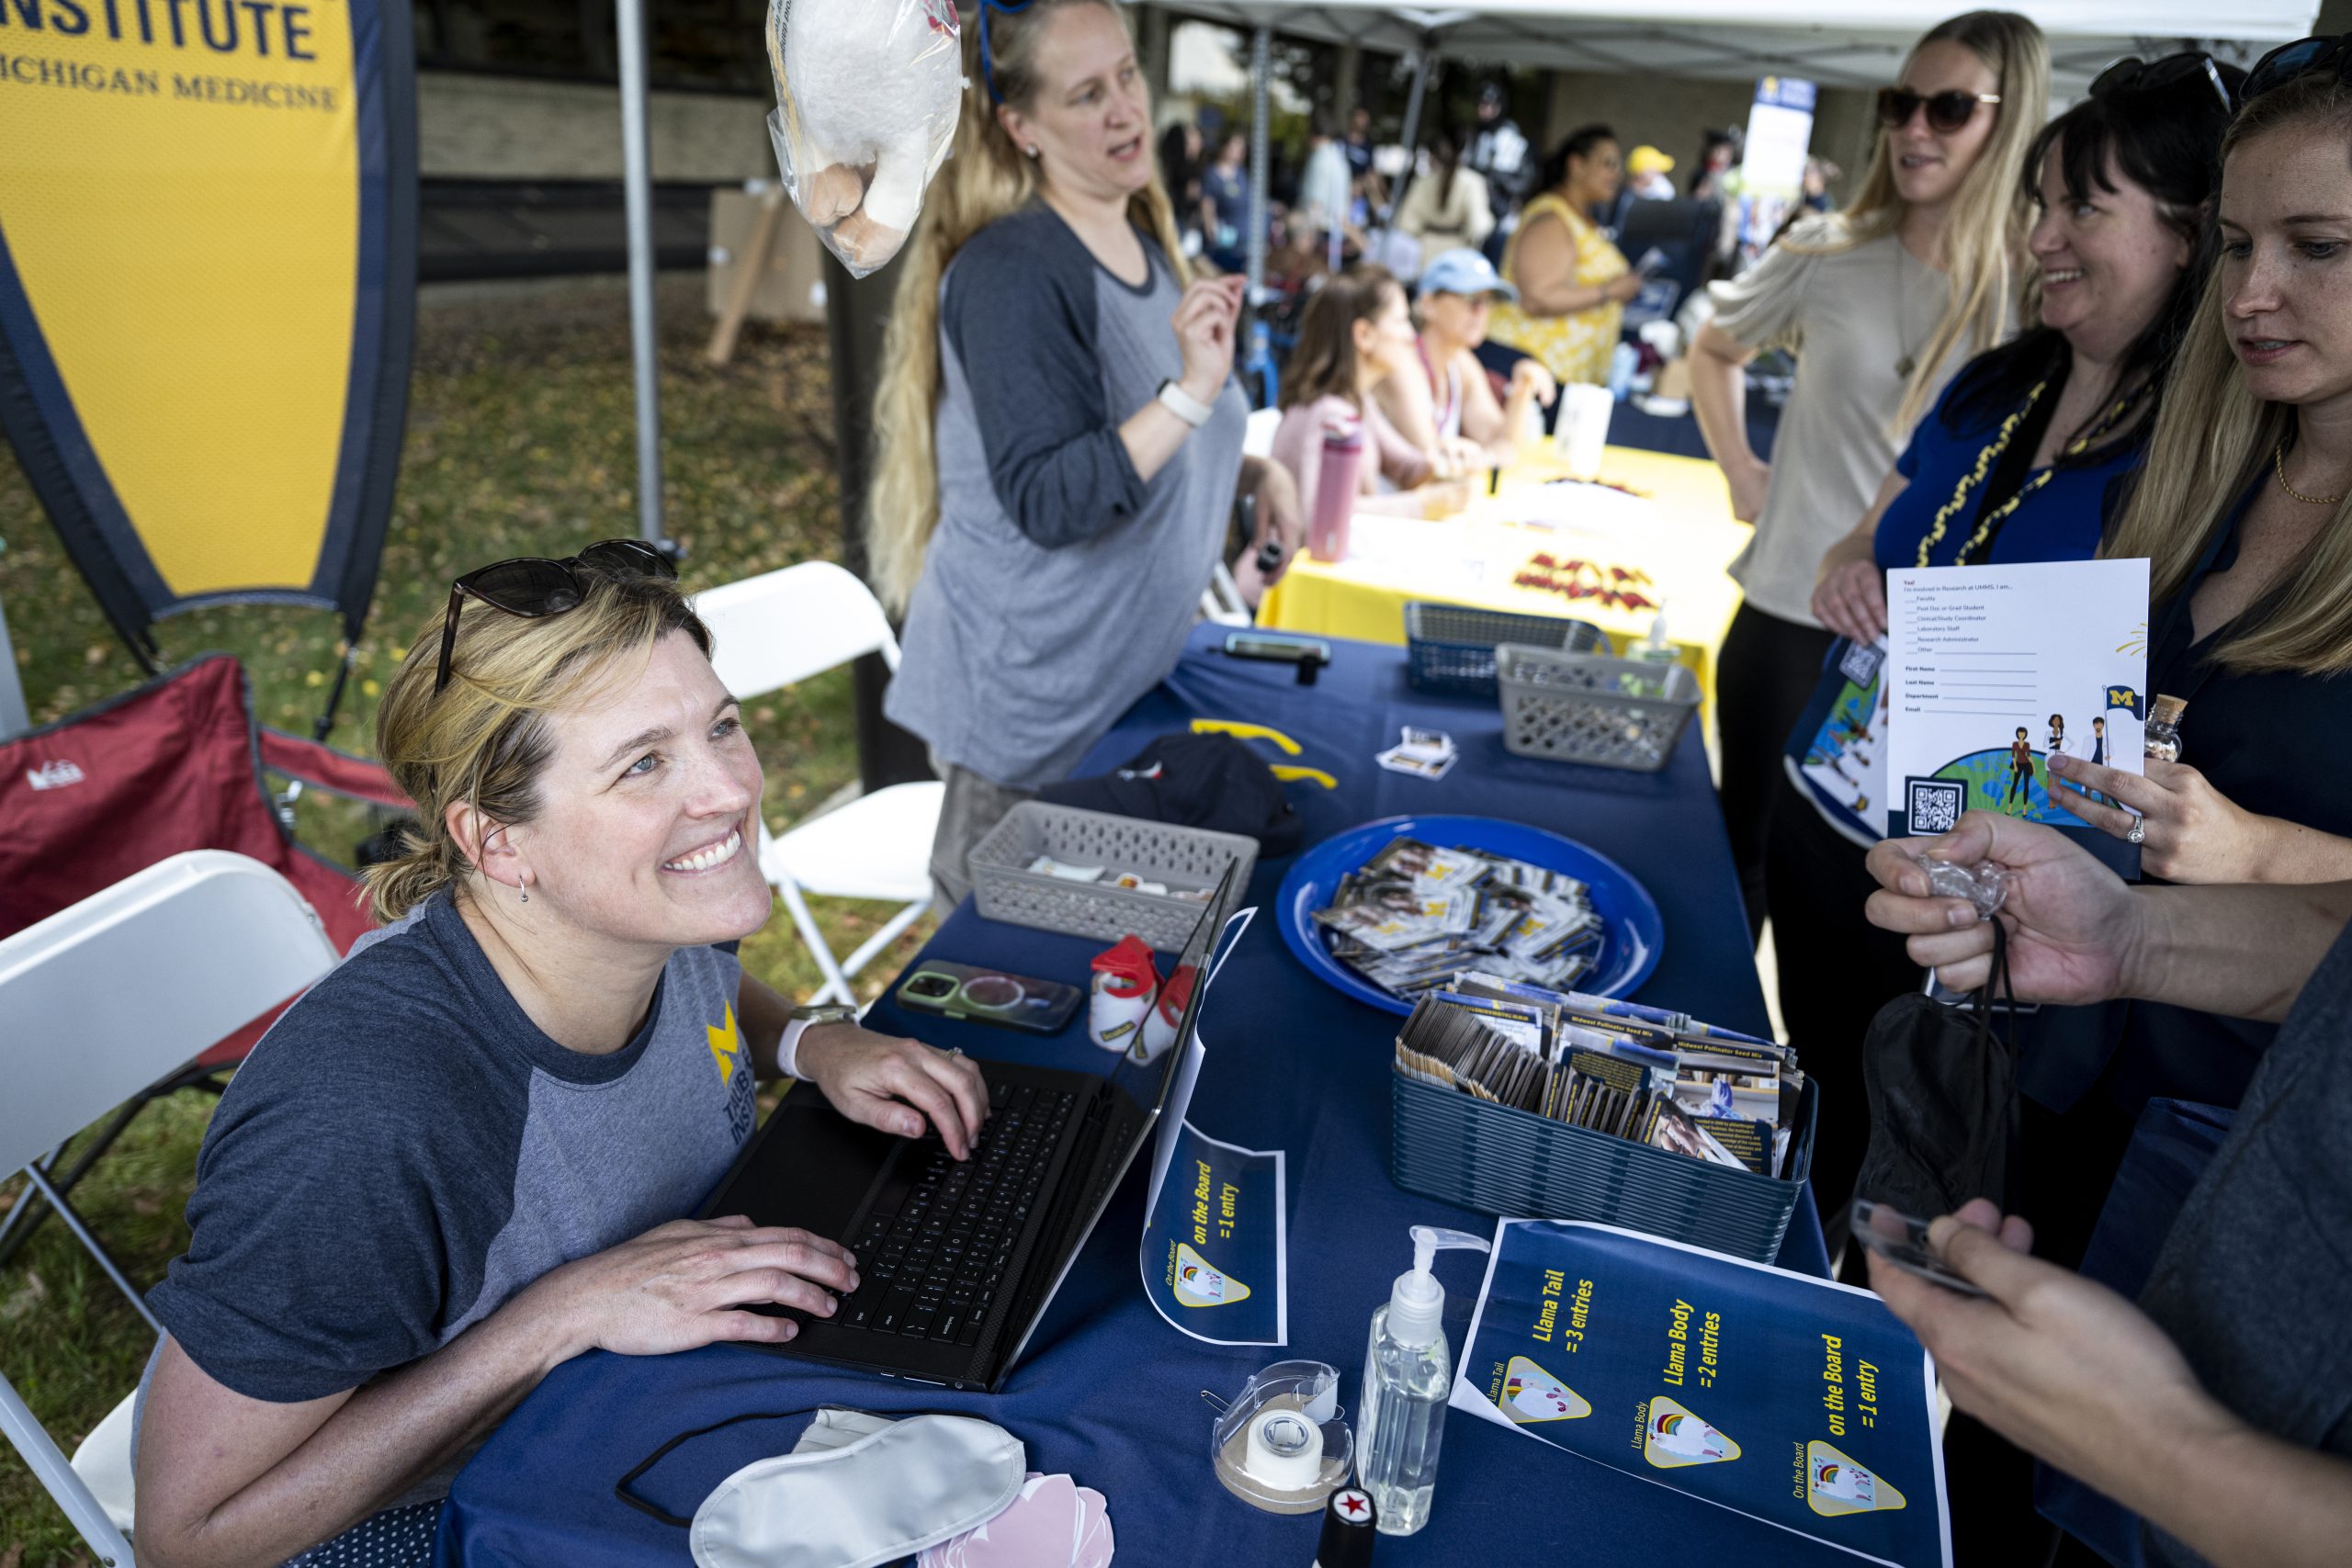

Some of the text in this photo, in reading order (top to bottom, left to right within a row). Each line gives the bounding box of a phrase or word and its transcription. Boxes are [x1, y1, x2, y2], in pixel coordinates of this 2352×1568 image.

[172, 72, 341, 114] MEDICINE
[1597, 1021, 1625, 1032] Pollinator
[1626, 1027, 1641, 1035] Seed
[1704, 1045, 1734, 1055] Pollinator
[723, 1070, 750, 1122] TAUB
[1192, 1159, 1212, 1245] on the Board
[1218, 1182, 1239, 1218] entry
[1218, 1218, 1235, 1228] 1
[1165, 1274, 1172, 1286] On
[1532, 1269, 1565, 1342] Llama Tail
[1571, 1279, 1593, 1328] entries
[1566, 1329, 1584, 1341] 3
[1663, 1299, 1694, 1385] Llama Body
[1699, 1312, 1720, 1365] entries
[1493, 1361, 1505, 1376] Tail
[1698, 1366, 1716, 1378] 2
[1821, 1334, 1845, 1437] on the Board
[1856, 1359, 1880, 1403] entry
[1632, 1402, 1649, 1450] Llama Body
[1858, 1404, 1877, 1416] 1
[1793, 1442, 1804, 1499] On the Board
